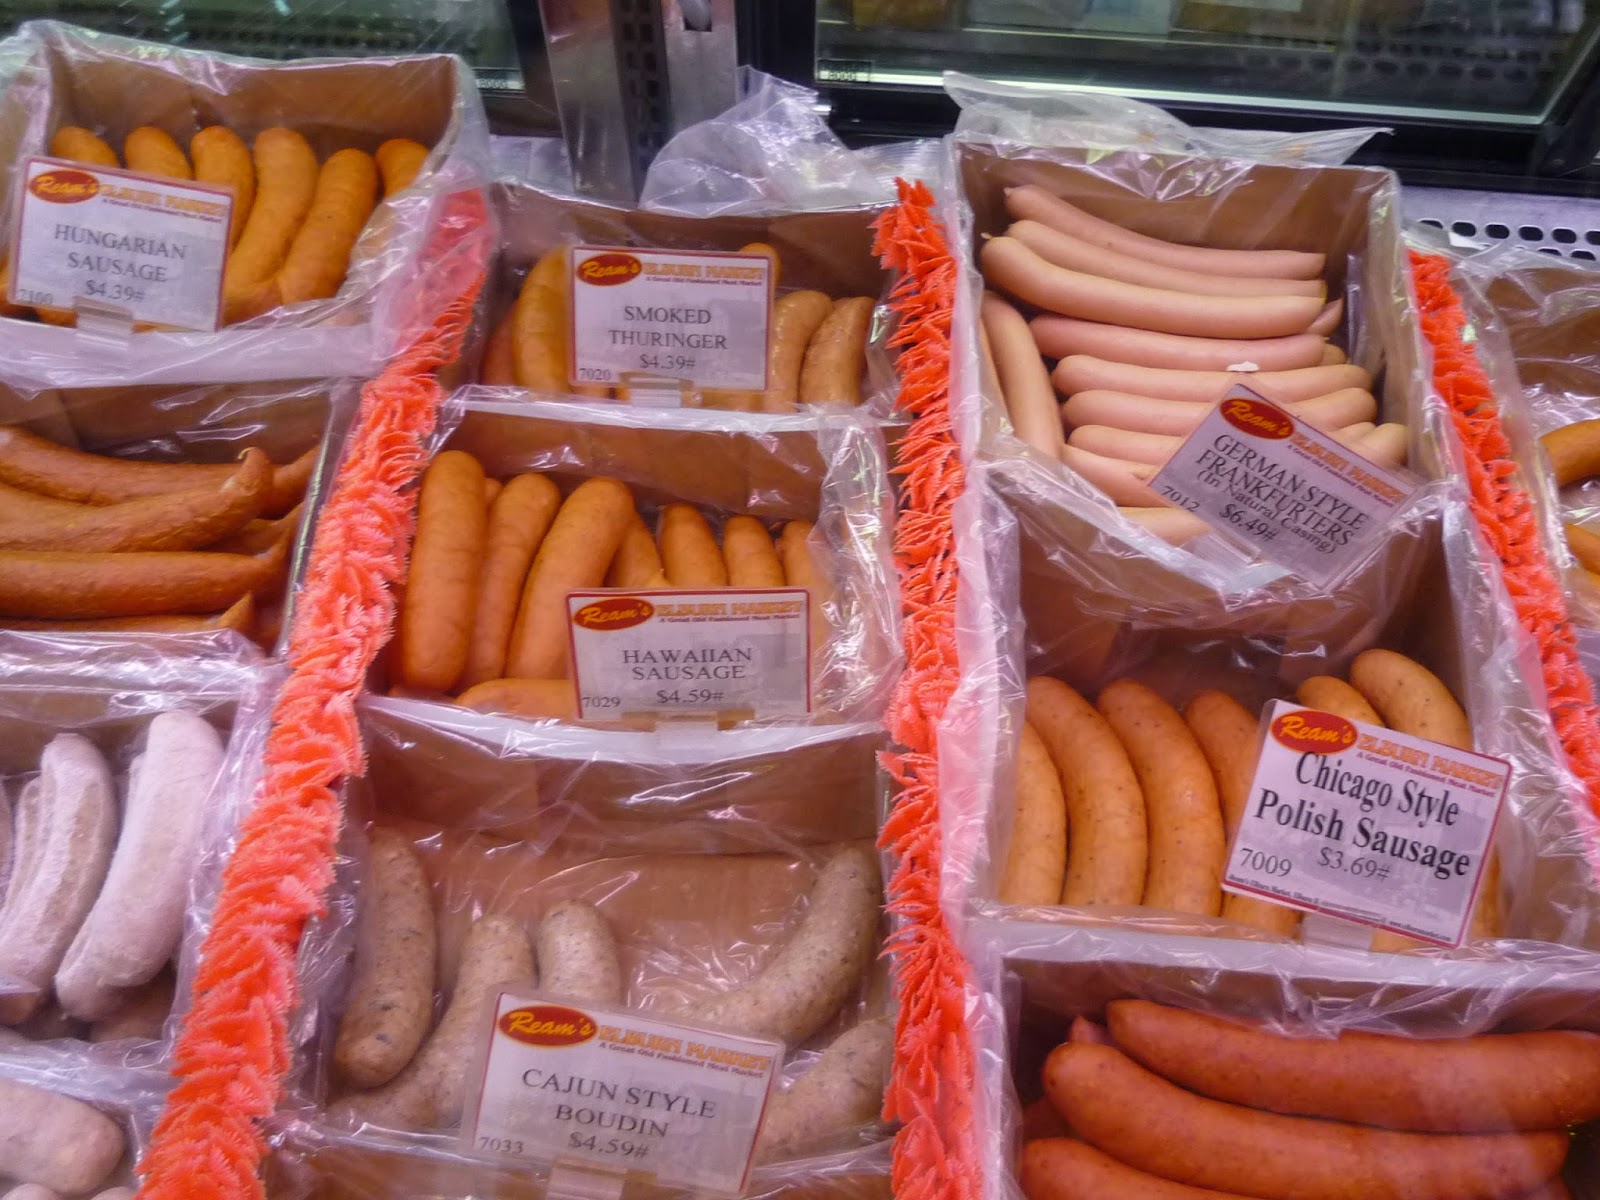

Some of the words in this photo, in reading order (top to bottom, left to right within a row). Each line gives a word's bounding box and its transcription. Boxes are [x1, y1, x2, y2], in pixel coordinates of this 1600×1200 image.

[54, 223, 188, 260] HUNGARIAN
[67, 252, 168, 282] SAUSAGE
[582, 259, 640, 278] Ream's
[624, 305, 712, 325] SMOKED
[608, 330, 728, 350] THURINGER
[579, 367, 612, 381] 7020
[1226, 400, 1291, 438] Ream's
[1196, 449, 1354, 547] FRANKFURTERS
[1213, 434, 1307, 494] GERMAN
[1301, 485, 1369, 532] STYLE
[1161, 485, 1200, 513] 7012
[1197, 469, 1221, 488] (In
[1227, 482, 1278, 521] Natural
[1281, 515, 1336, 555] Casing)
[1219, 503, 1277, 542] $6.49#
[581, 602, 650, 624] Ream's
[622, 648, 752, 665] HAWAIIAN
[632, 665, 746, 681] SAUSAGE
[583, 696, 620, 708] 7029
[656, 689, 724, 705] $4.59#
[1279, 714, 1355, 744] Ream's
[1296, 751, 1392, 812] Chicago
[1398, 779, 1459, 828] Style
[1253, 788, 1344, 841] Polish
[1352, 818, 1470, 880] Sausage
[1239, 847, 1292, 877] 7009
[1317, 846, 1391, 882] $3.69#
[508, 1011, 594, 1037] Ream's
[522, 1068, 618, 1100] CAJUN
[624, 1087, 717, 1119] STYLE
[554, 1104, 672, 1137] BOUDIN
[479, 1136, 524, 1154] 7033
[568, 1131, 649, 1158] $4.59#
